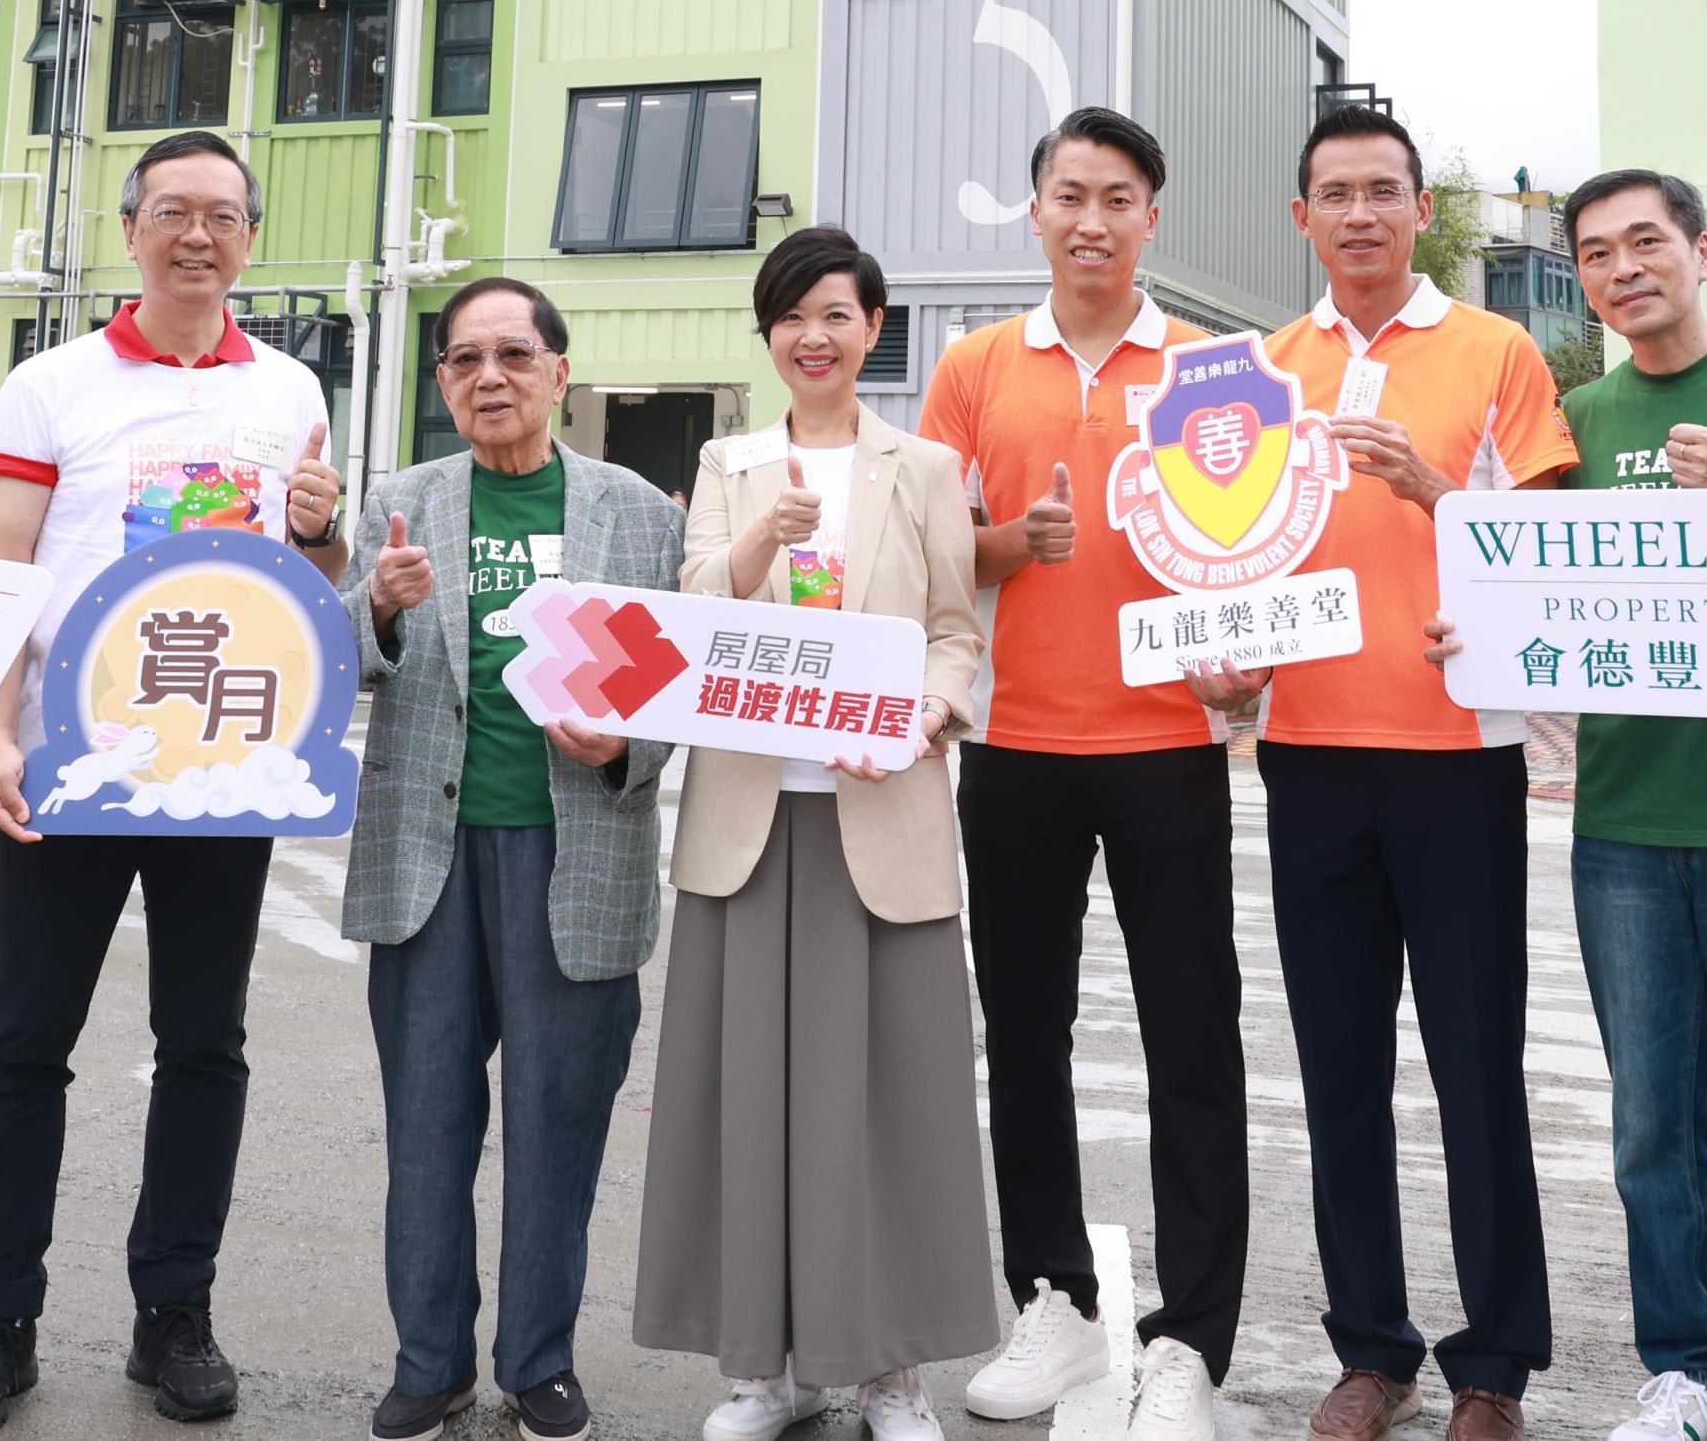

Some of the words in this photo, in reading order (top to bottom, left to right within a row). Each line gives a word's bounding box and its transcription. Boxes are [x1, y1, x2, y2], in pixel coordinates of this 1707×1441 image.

[129, 444, 193, 458] HAPPY
[1615, 448, 1672, 477] TEA
[471, 536, 532, 563] TEA
[1165, 552, 1204, 582] TONG
[1207, 535, 1295, 585] BENEVOLENT
[1285, 479, 1320, 541] SOCIETY
[1129, 588, 1349, 655] 九龍樂善堂
[704, 630, 834, 680] 房屋局
[1269, 639, 1303, 658] 成立
[132, 610, 278, 744] 賞月
[695, 674, 916, 739] 過渡性房屋
